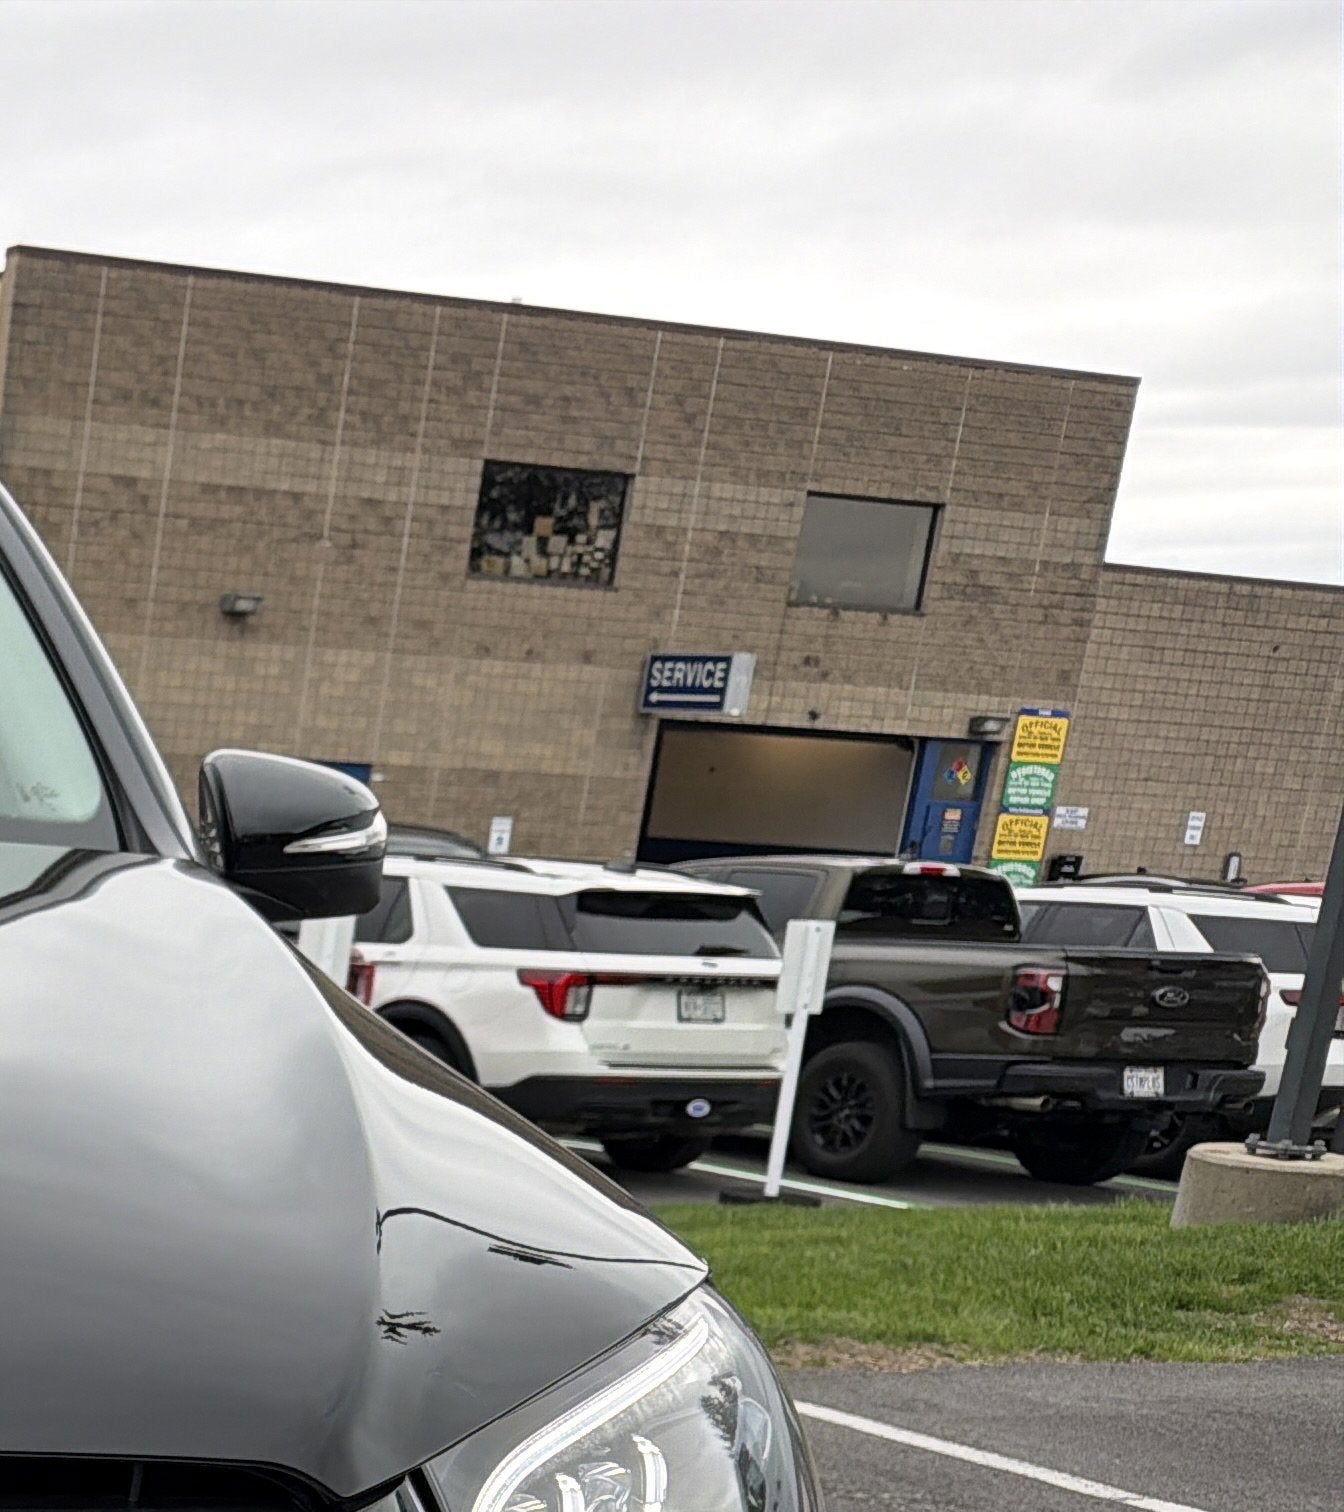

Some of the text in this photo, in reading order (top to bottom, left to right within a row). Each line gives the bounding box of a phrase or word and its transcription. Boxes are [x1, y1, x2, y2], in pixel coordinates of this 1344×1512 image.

[650, 661, 728, 689] SERVICE
[1020, 720, 1063, 736] OFFICIAL
[1001, 818, 1043, 833] OFFICIAL
